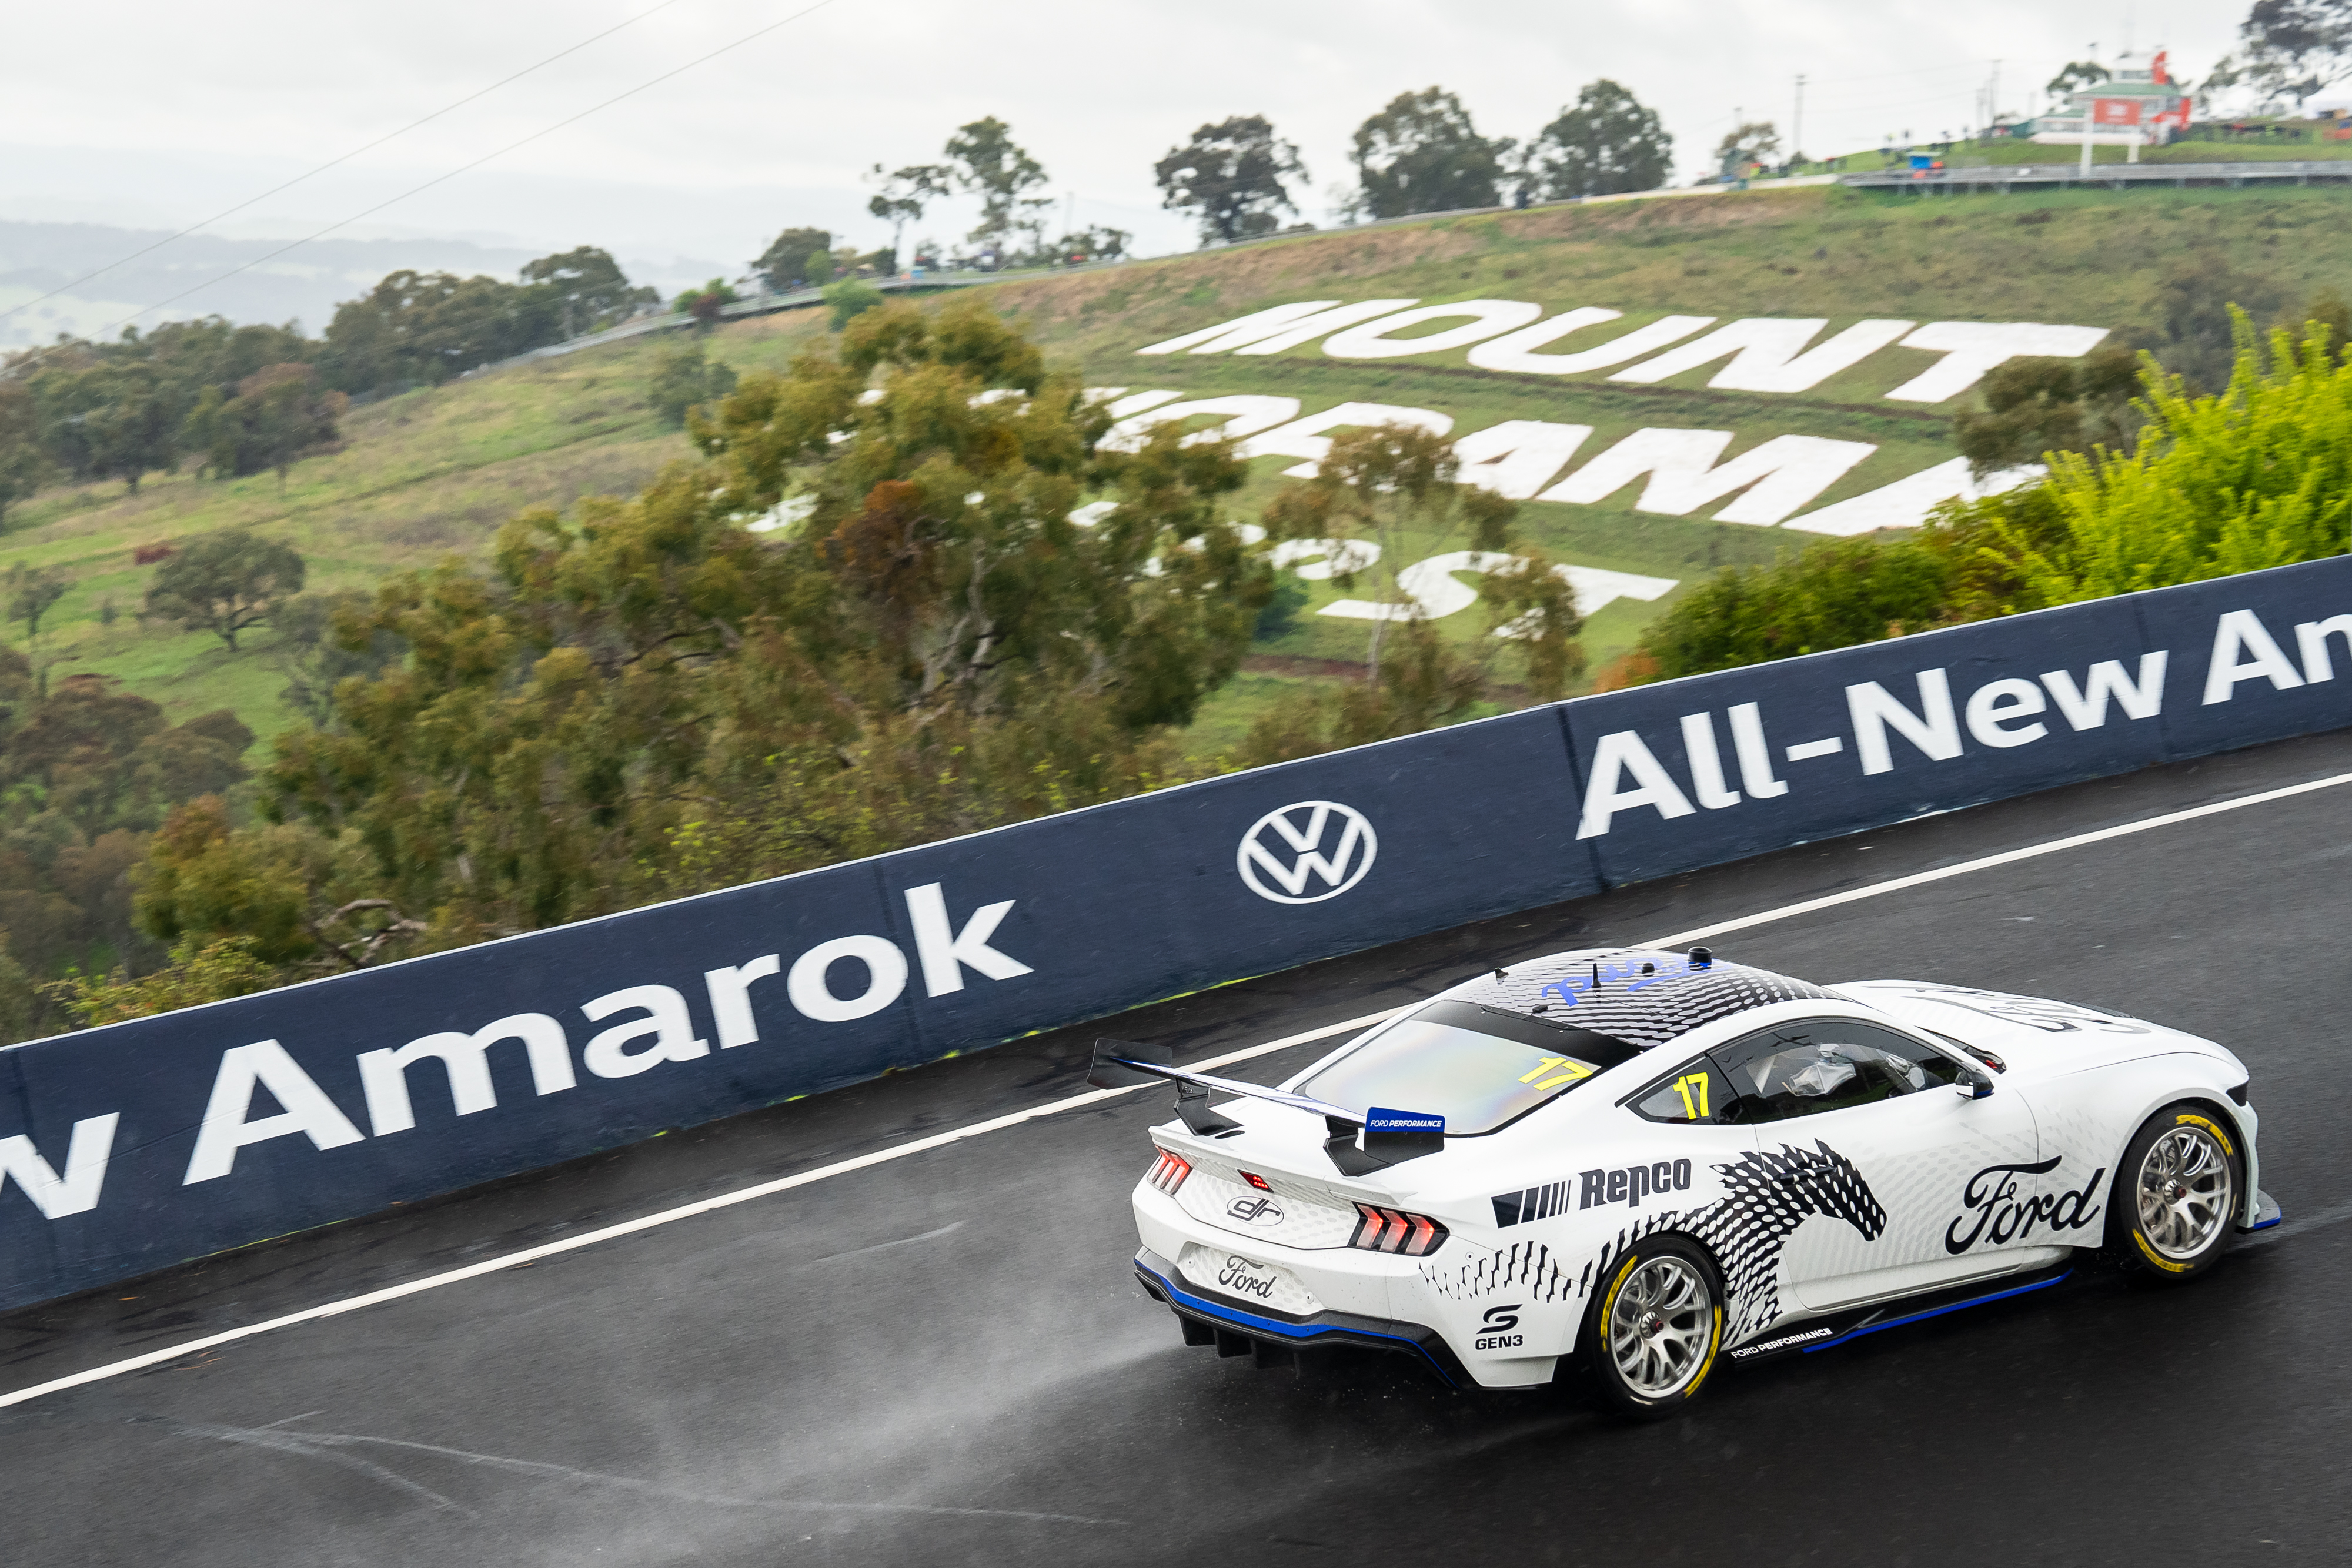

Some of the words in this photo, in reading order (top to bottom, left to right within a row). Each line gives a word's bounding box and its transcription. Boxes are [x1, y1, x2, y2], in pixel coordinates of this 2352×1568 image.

[1138, 299, 2110, 403] MOUNT
[1576, 651, 2168, 840] All-New
[183, 882, 1034, 1186] Amarok
[1518, 1057, 1593, 1091] 17
[1673, 1072, 1709, 1119] 17
[1370, 1119, 1389, 1128] FORD
[1388, 1119, 1442, 1128] PERFORMANCE
[1579, 1158, 1692, 1208] Repco
[1945, 1155, 2106, 1256] Ford
[1218, 1255, 1277, 1299] Ford
[1475, 1335, 1524, 1350] GEN3
[1730, 1346, 1759, 1359] FORD
[1757, 1328, 1833, 1352] PERFORMANCE
